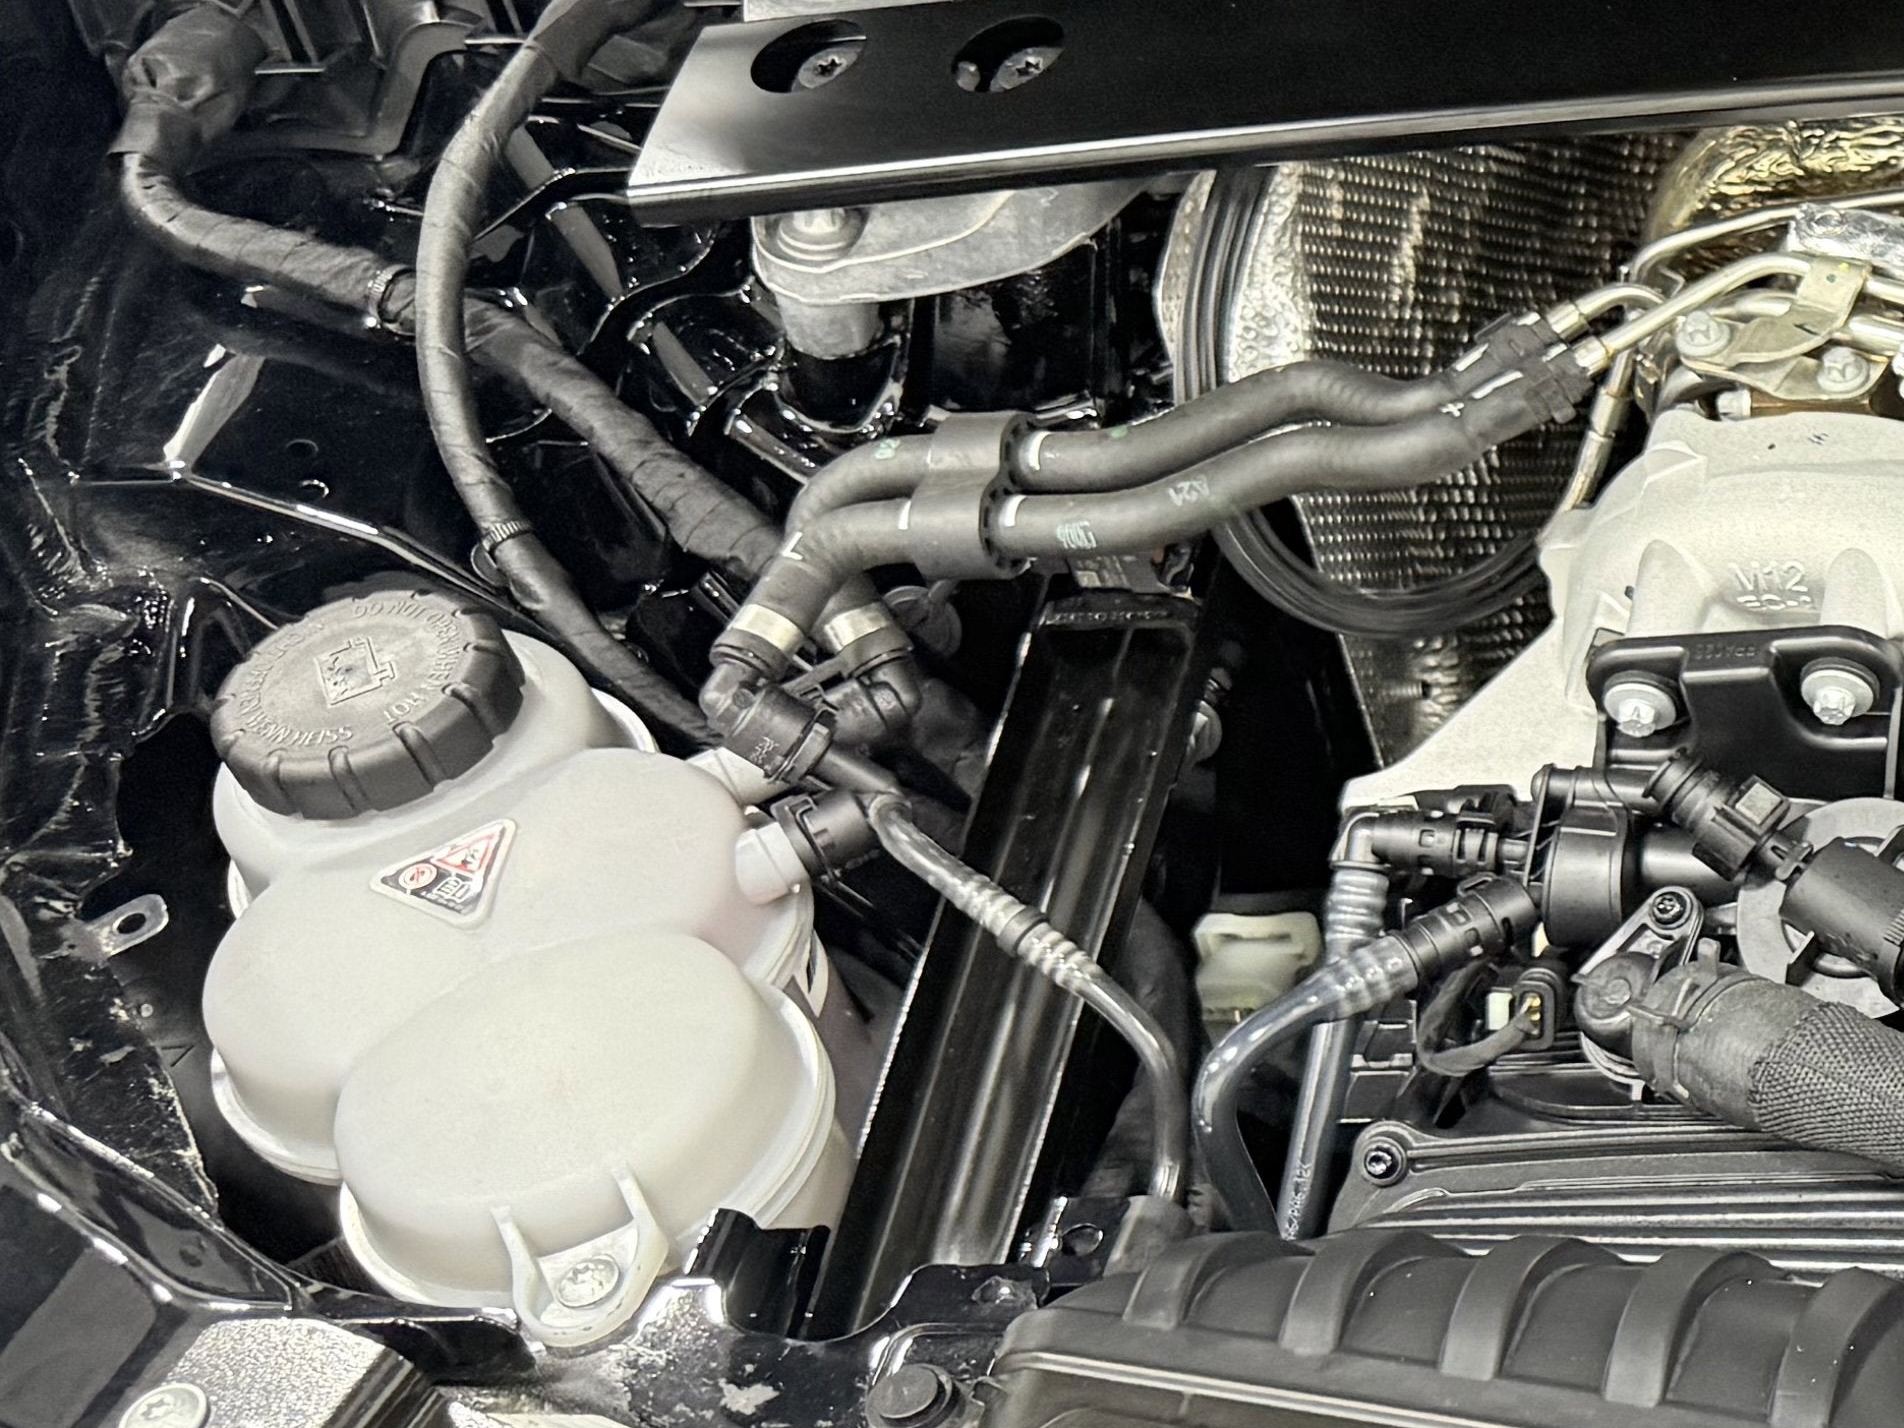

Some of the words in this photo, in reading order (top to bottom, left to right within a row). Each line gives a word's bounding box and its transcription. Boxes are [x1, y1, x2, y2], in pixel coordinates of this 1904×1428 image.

[355, 603, 385, 618] DO
[387, 600, 424, 619] NOT
[427, 612, 460, 642] OPEN
[383, 691, 425, 723] HOT
[291, 726, 354, 746] HEISS
